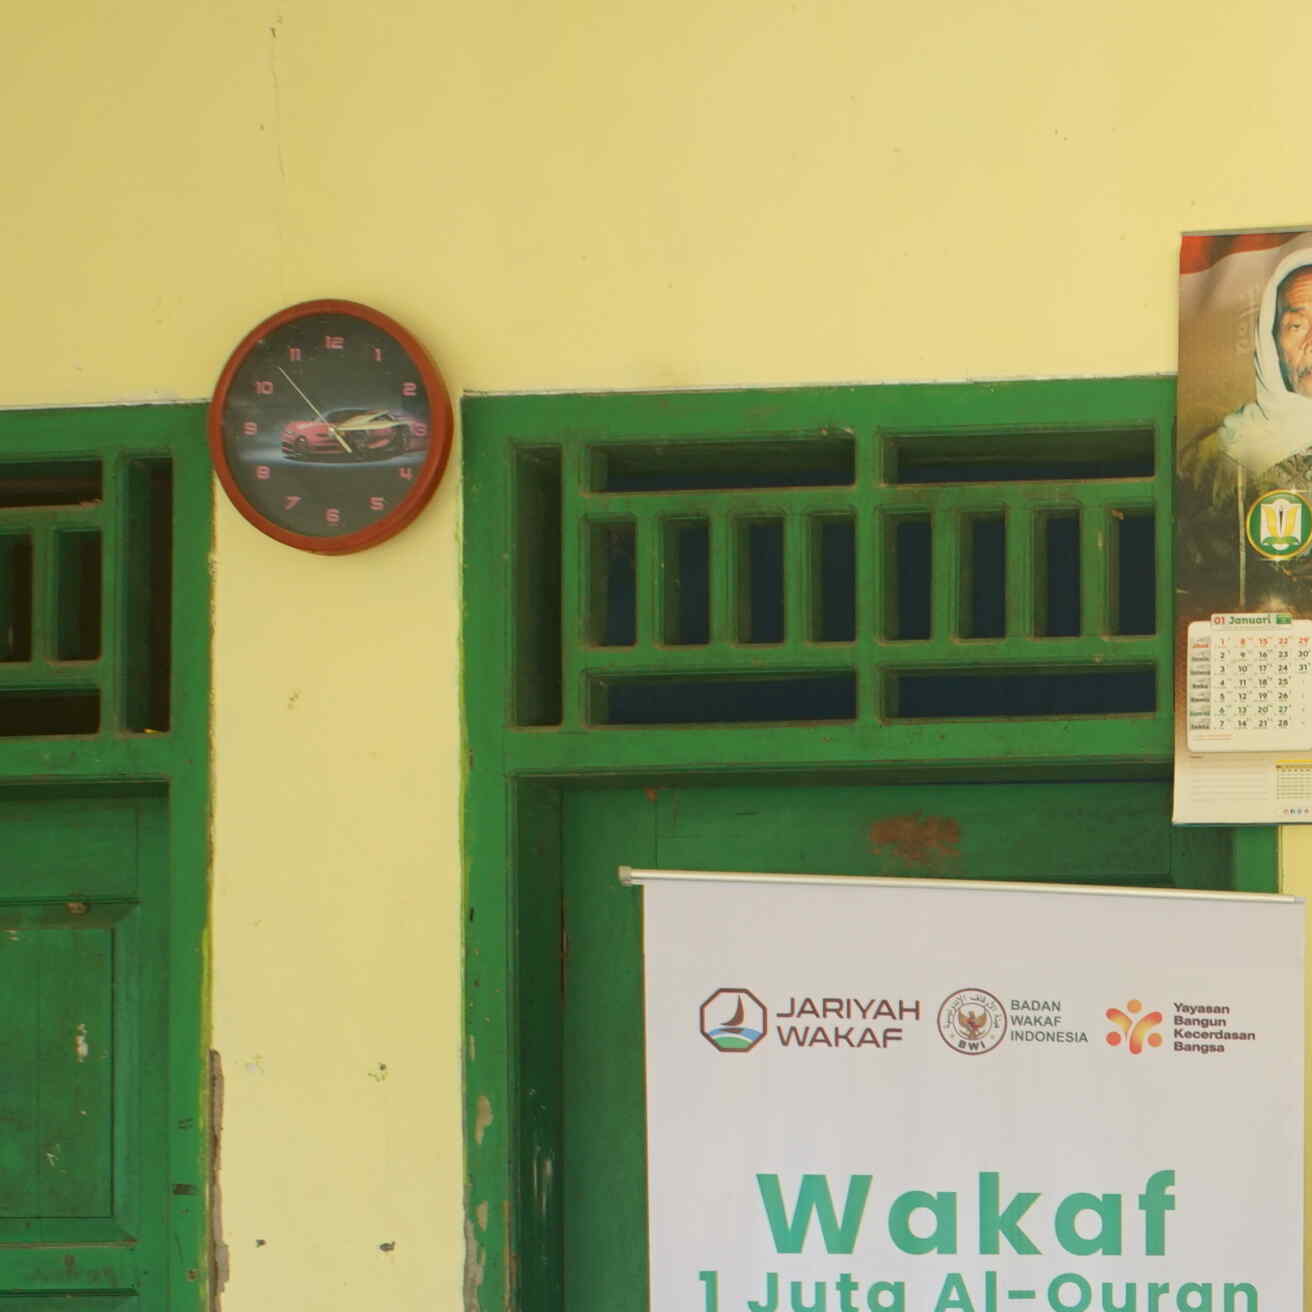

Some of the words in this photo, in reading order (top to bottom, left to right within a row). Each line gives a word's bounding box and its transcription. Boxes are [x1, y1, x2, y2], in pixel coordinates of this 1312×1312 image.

[325, 336, 344, 349] 12
[289, 348, 300, 361] 11
[375, 349, 381, 361] 1
[256, 381, 273, 394] 10
[402, 382, 417, 396] 2
[243, 422, 257, 436] 9
[257, 465, 270, 479] 8
[400, 468, 413, 479] 4
[284, 496, 301, 510] 7
[369, 497, 384, 510] 5
[326, 508, 340, 522] 6
[1229, 616, 1271, 624] Januari
[776, 998, 920, 1021] JARIYAH
[1010, 1000, 1061, 1012] BADAN
[1174, 1003, 1230, 1016] Yayasan
[1010, 1015, 1062, 1027] WAKAF
[1174, 1016, 1226, 1029] Bangun
[777, 1026, 902, 1048] WAKAF
[1010, 1030, 1088, 1043] INDONESIA
[1174, 1029, 1256, 1041] Kecerdasan
[958, 1040, 986, 1051] BWI
[1174, 1041, 1225, 1053] Bangsa
[756, 1169, 1176, 1257] Wakaf
